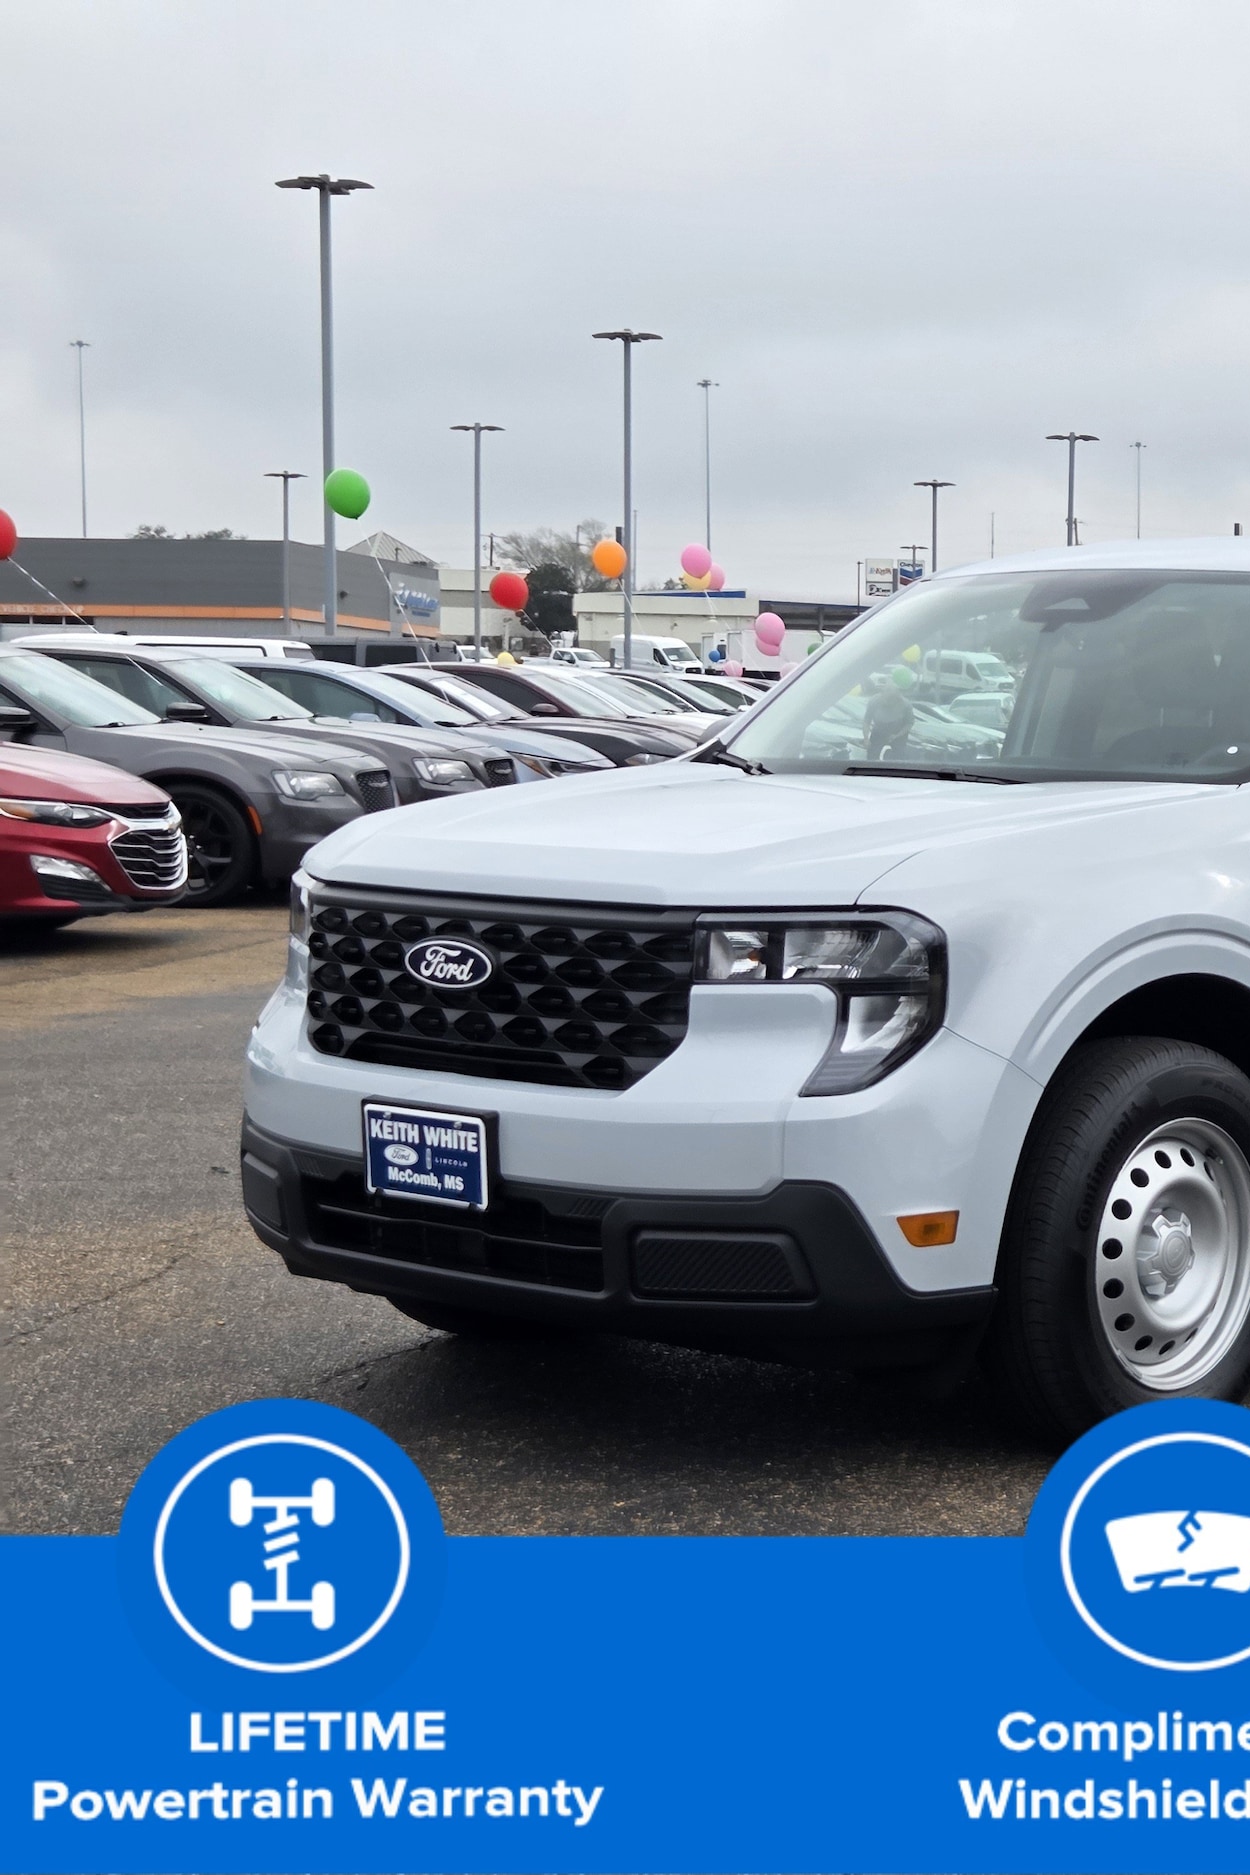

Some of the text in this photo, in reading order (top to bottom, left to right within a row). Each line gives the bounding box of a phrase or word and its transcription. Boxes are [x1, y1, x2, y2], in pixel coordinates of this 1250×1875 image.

[420, 946, 474, 981] Ford
[370, 1118, 478, 1152] KEITH WHITE
[391, 1147, 411, 1161] Ford
[435, 1157, 468, 1167] LINCOLN
[387, 1166, 464, 1191] McComb, MS
